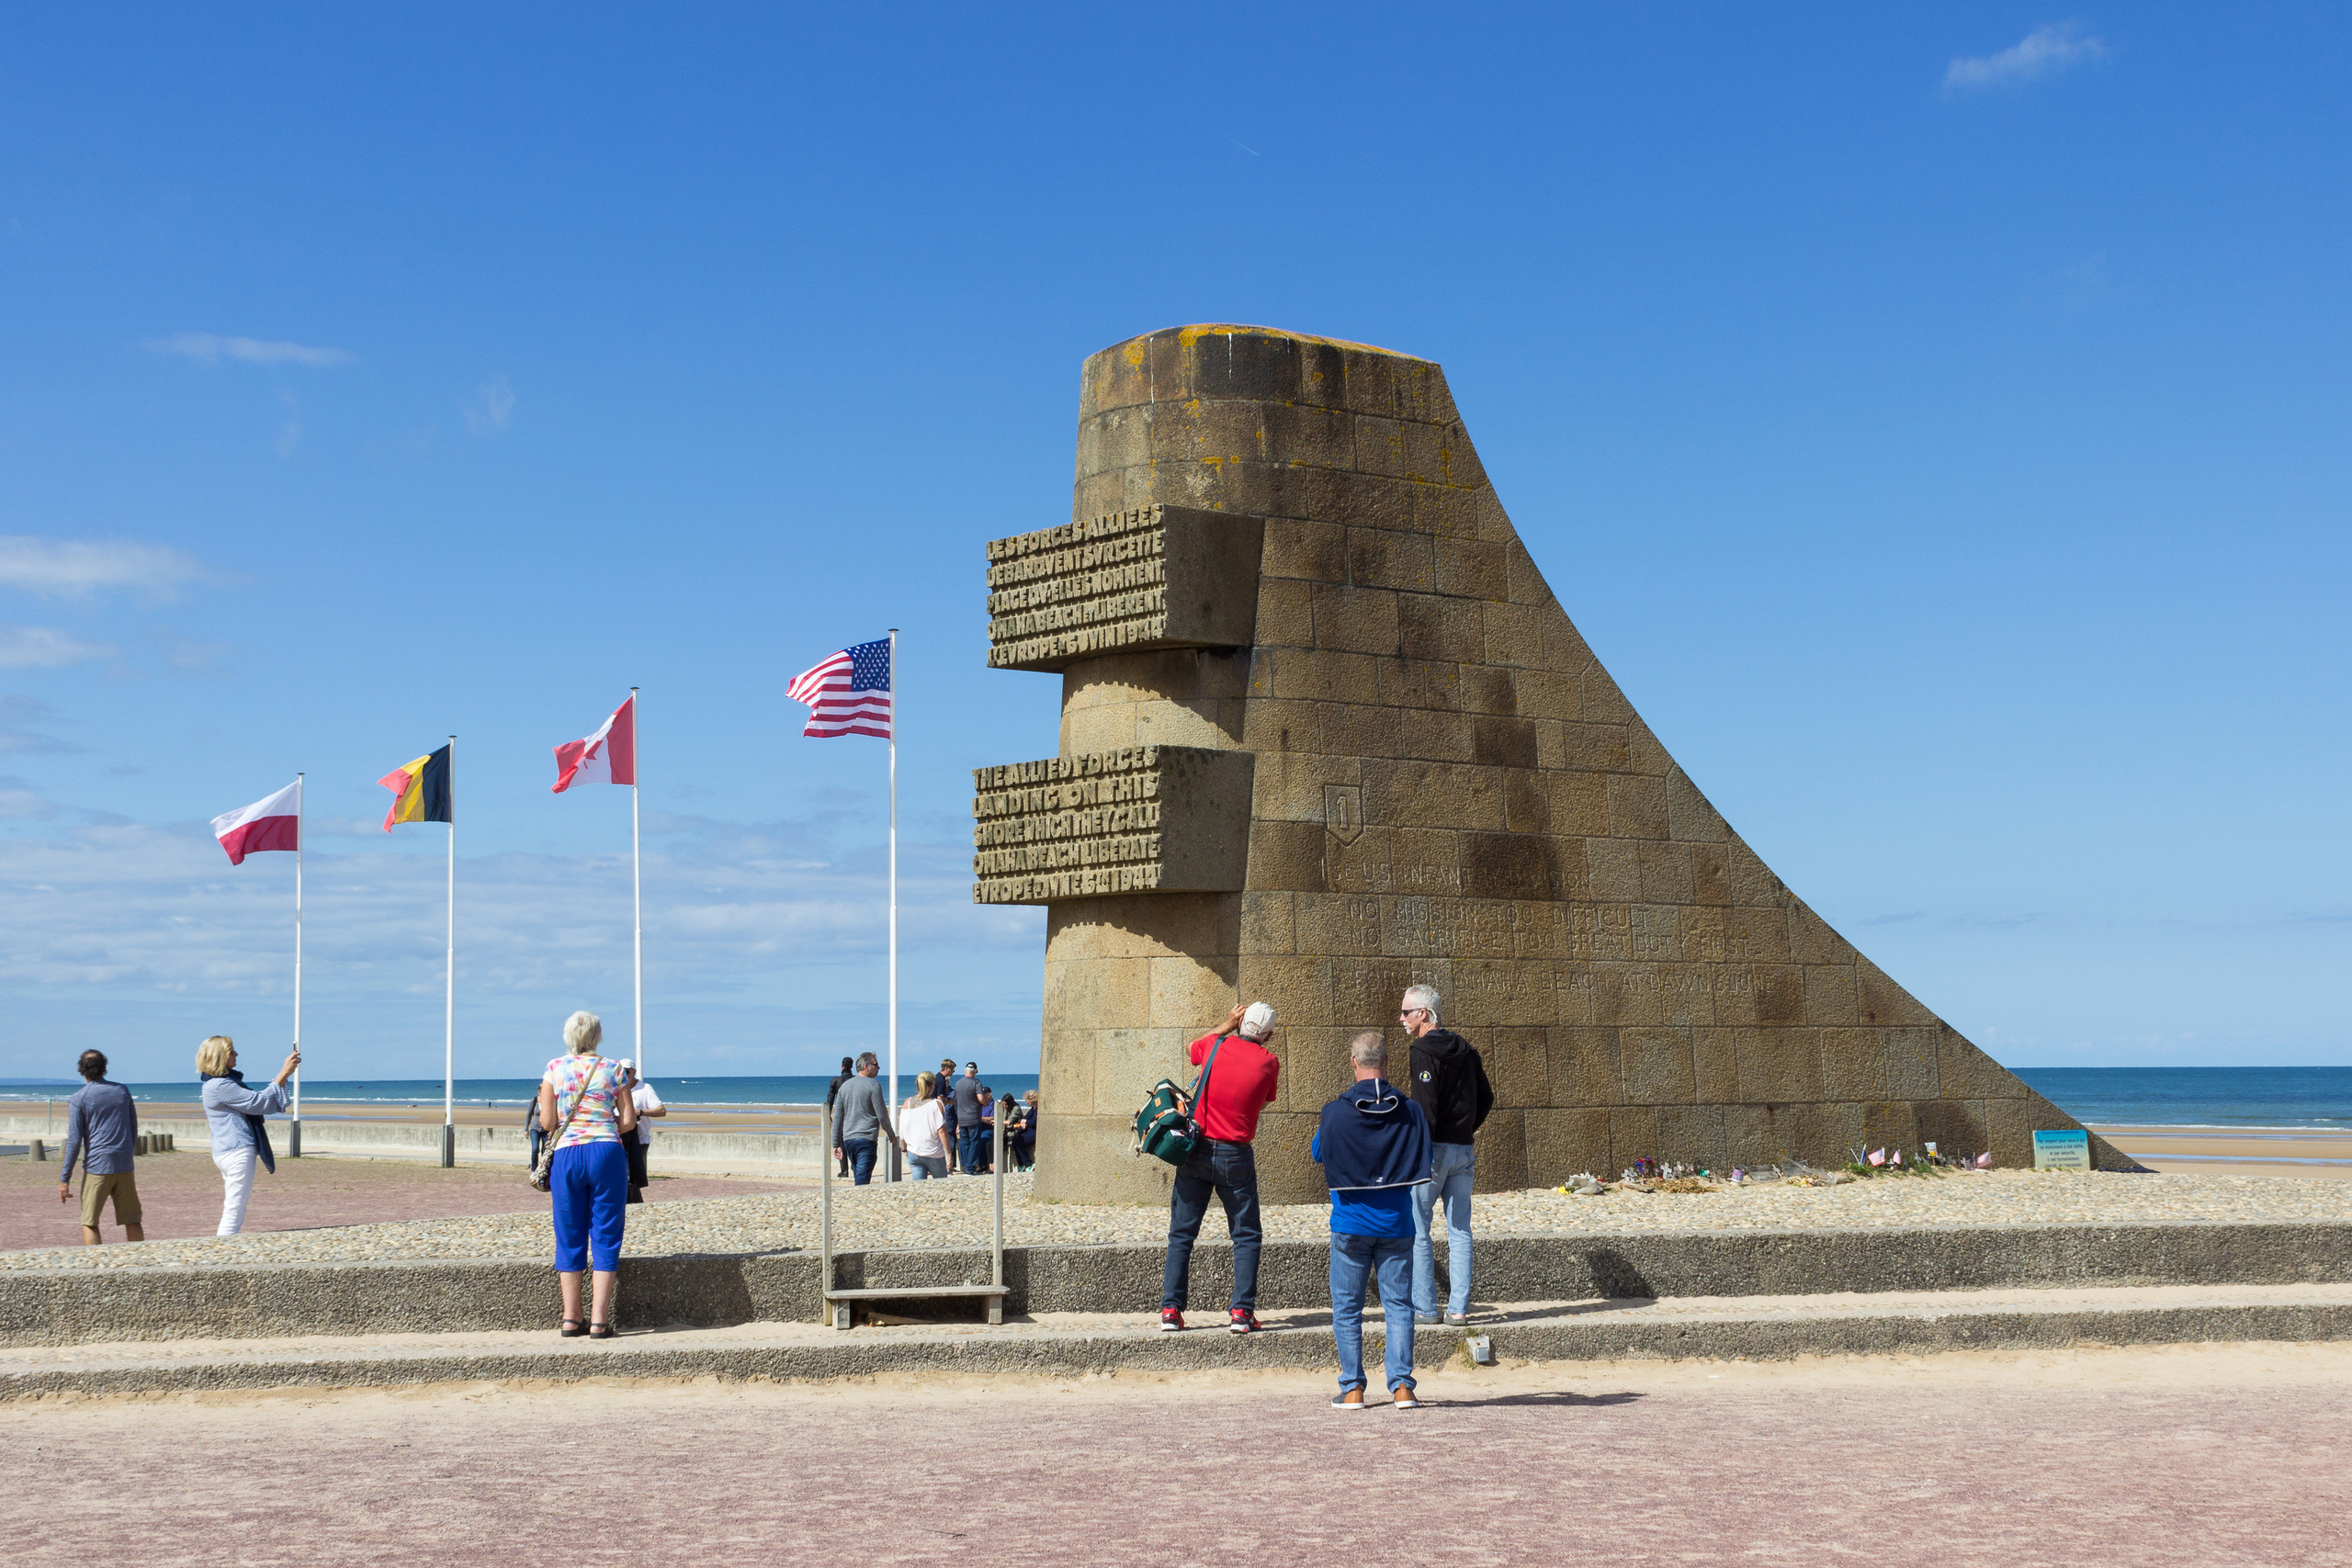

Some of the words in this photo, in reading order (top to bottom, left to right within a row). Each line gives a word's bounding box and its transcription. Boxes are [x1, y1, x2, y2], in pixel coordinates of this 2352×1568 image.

[987, 536, 1016, 561] LES
[1016, 521, 1084, 555] FORCES
[1084, 503, 1163, 541] ALLIEES
[1114, 530, 1164, 561] CETTE
[987, 614, 1037, 641] OMAHA
[1036, 604, 1083, 631] BEACH
[1116, 617, 1163, 646] 1944
[972, 765, 1005, 790] THE
[1005, 756, 1071, 786] ALLIED
[1071, 746, 1159, 776] FORCES
[972, 789, 1058, 818] LANDING
[1059, 782, 1097, 808] ON
[1098, 776, 1159, 803] THIS
[972, 822, 1024, 847] SHORE
[1024, 813, 1070, 840] WHICH
[1071, 809, 1111, 836] THEY
[1110, 804, 1160, 831] CALL
[972, 850, 1026, 874] OMAHA
[1026, 843, 1080, 870] BEACH
[1080, 836, 1160, 864] LIBERATE
[1111, 867, 1159, 893] 1944
[1363, 862, 1391, 883] US
[1349, 899, 1377, 920] NO
[1395, 900, 1477, 922] MISSION
[1492, 904, 1534, 926] TOO
[1552, 906, 1646, 930] DIFFICULT
[1351, 925, 1379, 947] NO
[1396, 927, 1504, 950] SACRIFICE
[1515, 931, 1556, 952] TOO
[1636, 934, 1687, 956] DUTY
[1453, 971, 1528, 992] OMAHA
[1541, 971, 1608, 992] BEACH
[1622, 972, 1643, 992] AT
[1649, 973, 1709, 993] DAWN
